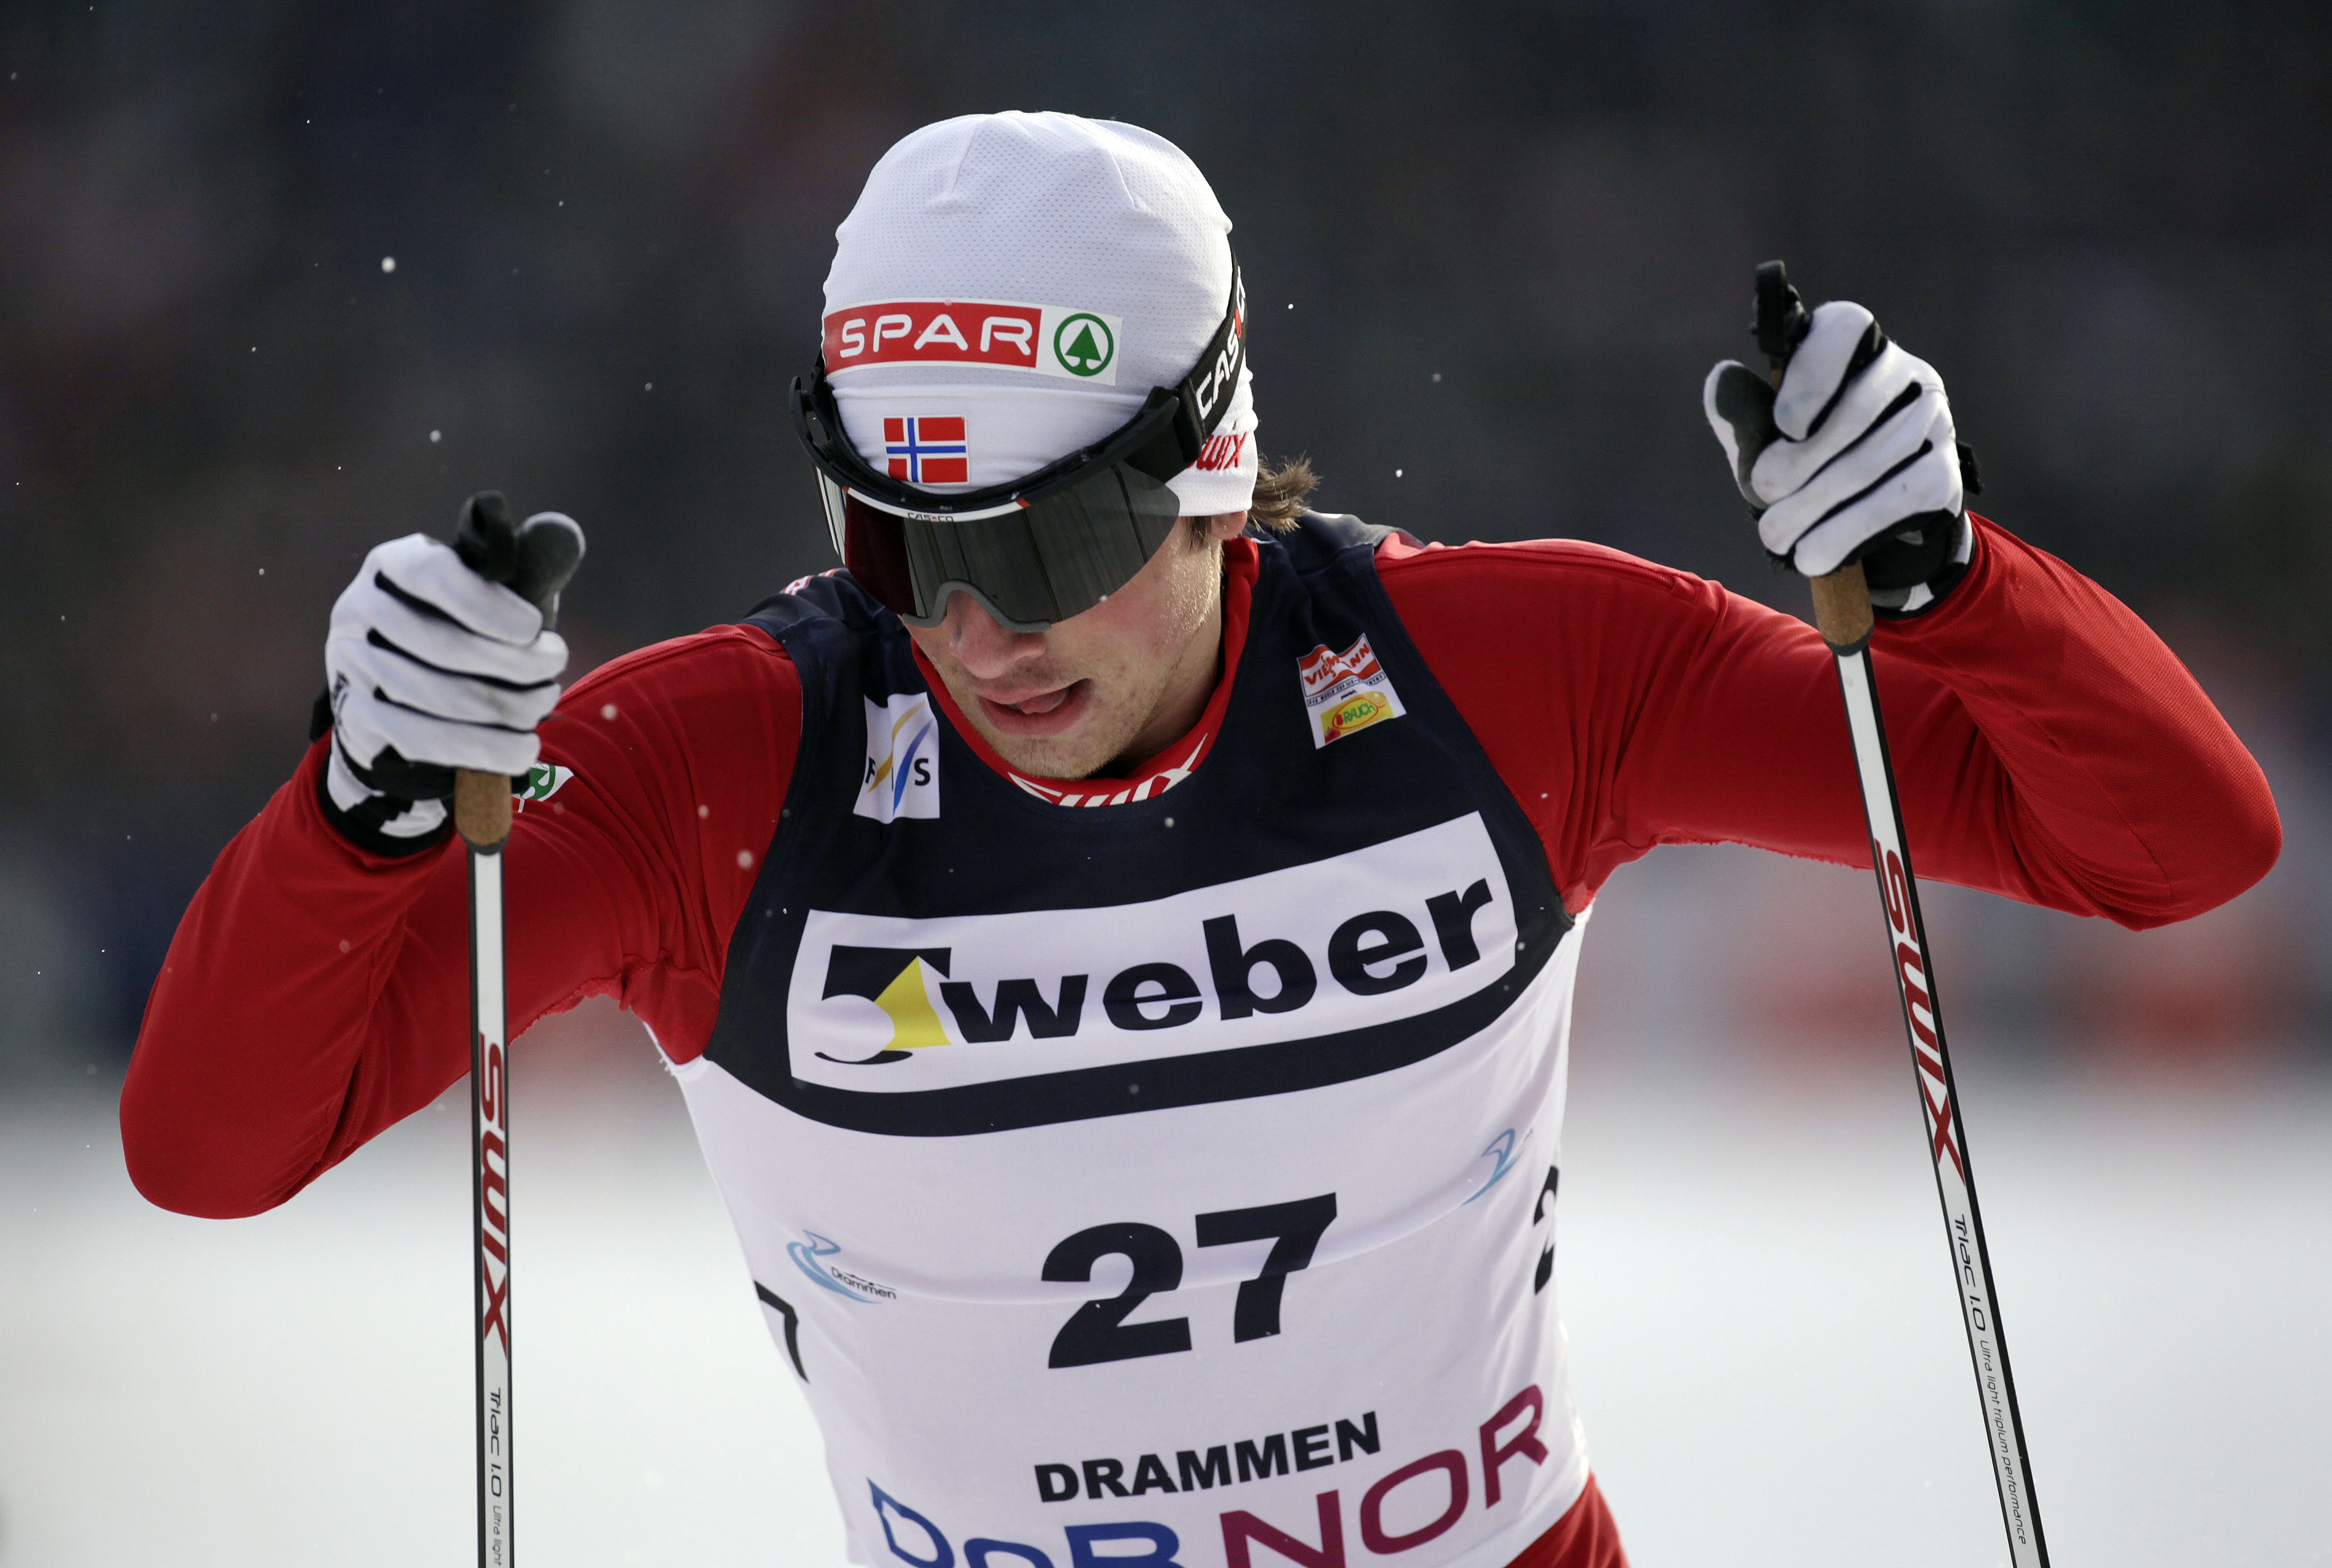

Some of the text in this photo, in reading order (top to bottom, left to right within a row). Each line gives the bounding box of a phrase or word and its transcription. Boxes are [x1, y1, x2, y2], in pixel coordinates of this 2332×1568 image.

[839, 313, 1033, 358] SPAR
[1196, 265, 1246, 419] CASC
[1187, 431, 1249, 471] WIX
[1343, 702, 1376, 724] RAUCH
[865, 757, 930, 791] FIS
[939, 878, 1493, 1044] weber
[1874, 838, 1966, 1187] SWIX
[479, 1031, 508, 1361] SWIX
[831, 1266, 897, 1300] Drammen
[1040, 1192, 1338, 1369] 27
[1980, 1340, 1993, 1372] Ultra
[1987, 1376, 2000, 1404] light
[1993, 1407, 2008, 1453] triplum
[1033, 1411, 1381, 1503] DRAMMEN
[493, 1505, 502, 1535] Ultra
[2001, 1456, 2026, 1545] performance
[492, 1540, 502, 1567] light
